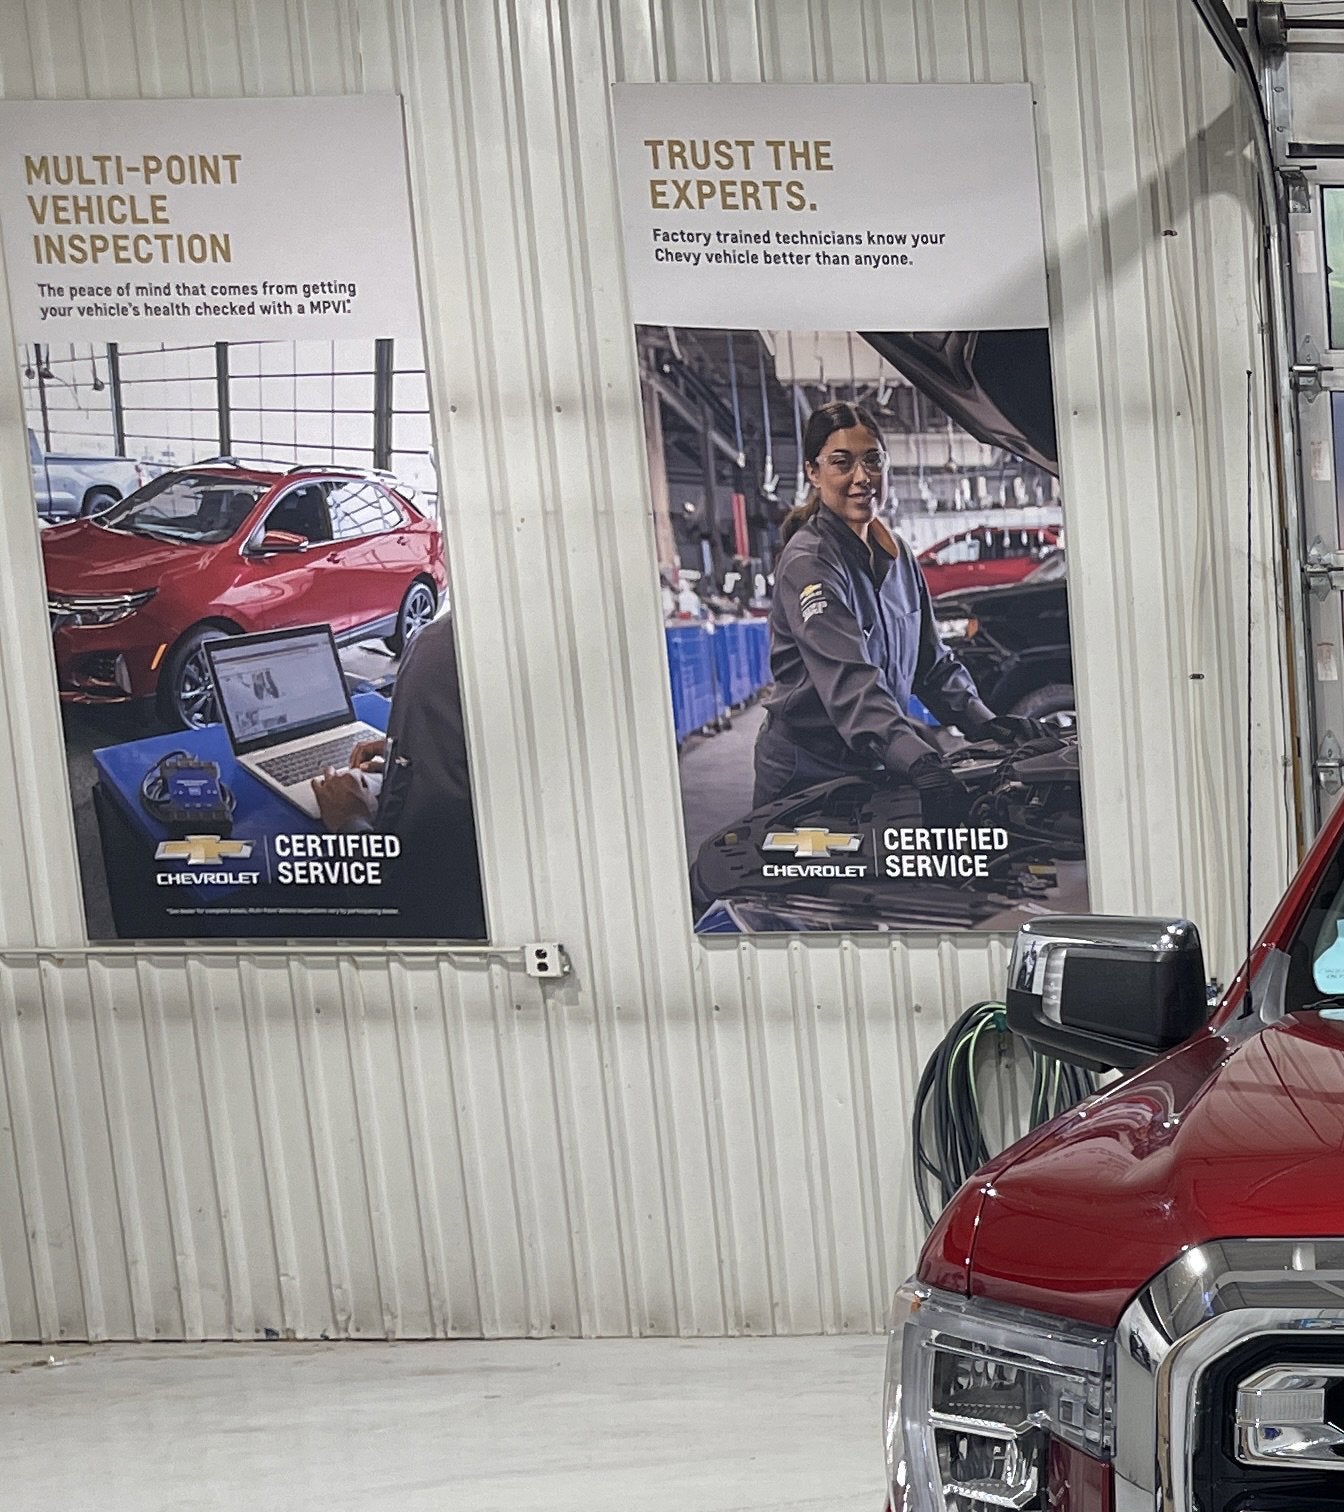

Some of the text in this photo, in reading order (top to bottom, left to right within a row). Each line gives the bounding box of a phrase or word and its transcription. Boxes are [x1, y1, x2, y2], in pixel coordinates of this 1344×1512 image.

[644, 140, 834, 171] TRUST THE
[25, 155, 242, 185] MULTI-POINT
[649, 180, 817, 211] EXPERTS.
[27, 195, 169, 224] VEHICLE
[33, 234, 231, 264] INSPECTION
[652, 228, 945, 248] Factory trained technicians know your
[655, 249, 914, 269] Chevy vehicle better than anyone.
[37, 280, 356, 300] The peace of mind that comes from getting
[40, 306, 73, 320] your
[77, 302, 140, 317] vehicle's
[144, 302, 190, 316] health
[195, 301, 255, 315] checked
[259, 300, 293, 315] with
[297, 304, 305, 314] a
[275, 834, 400, 858] CERTIFIED
[883, 827, 1008, 851] CERTIFIED
[277, 862, 382, 885] SERVICE
[762, 864, 867, 878] CHEVROLET
[885, 854, 989, 877] SERVICE
[156, 872, 260, 886] CHEVROLET
